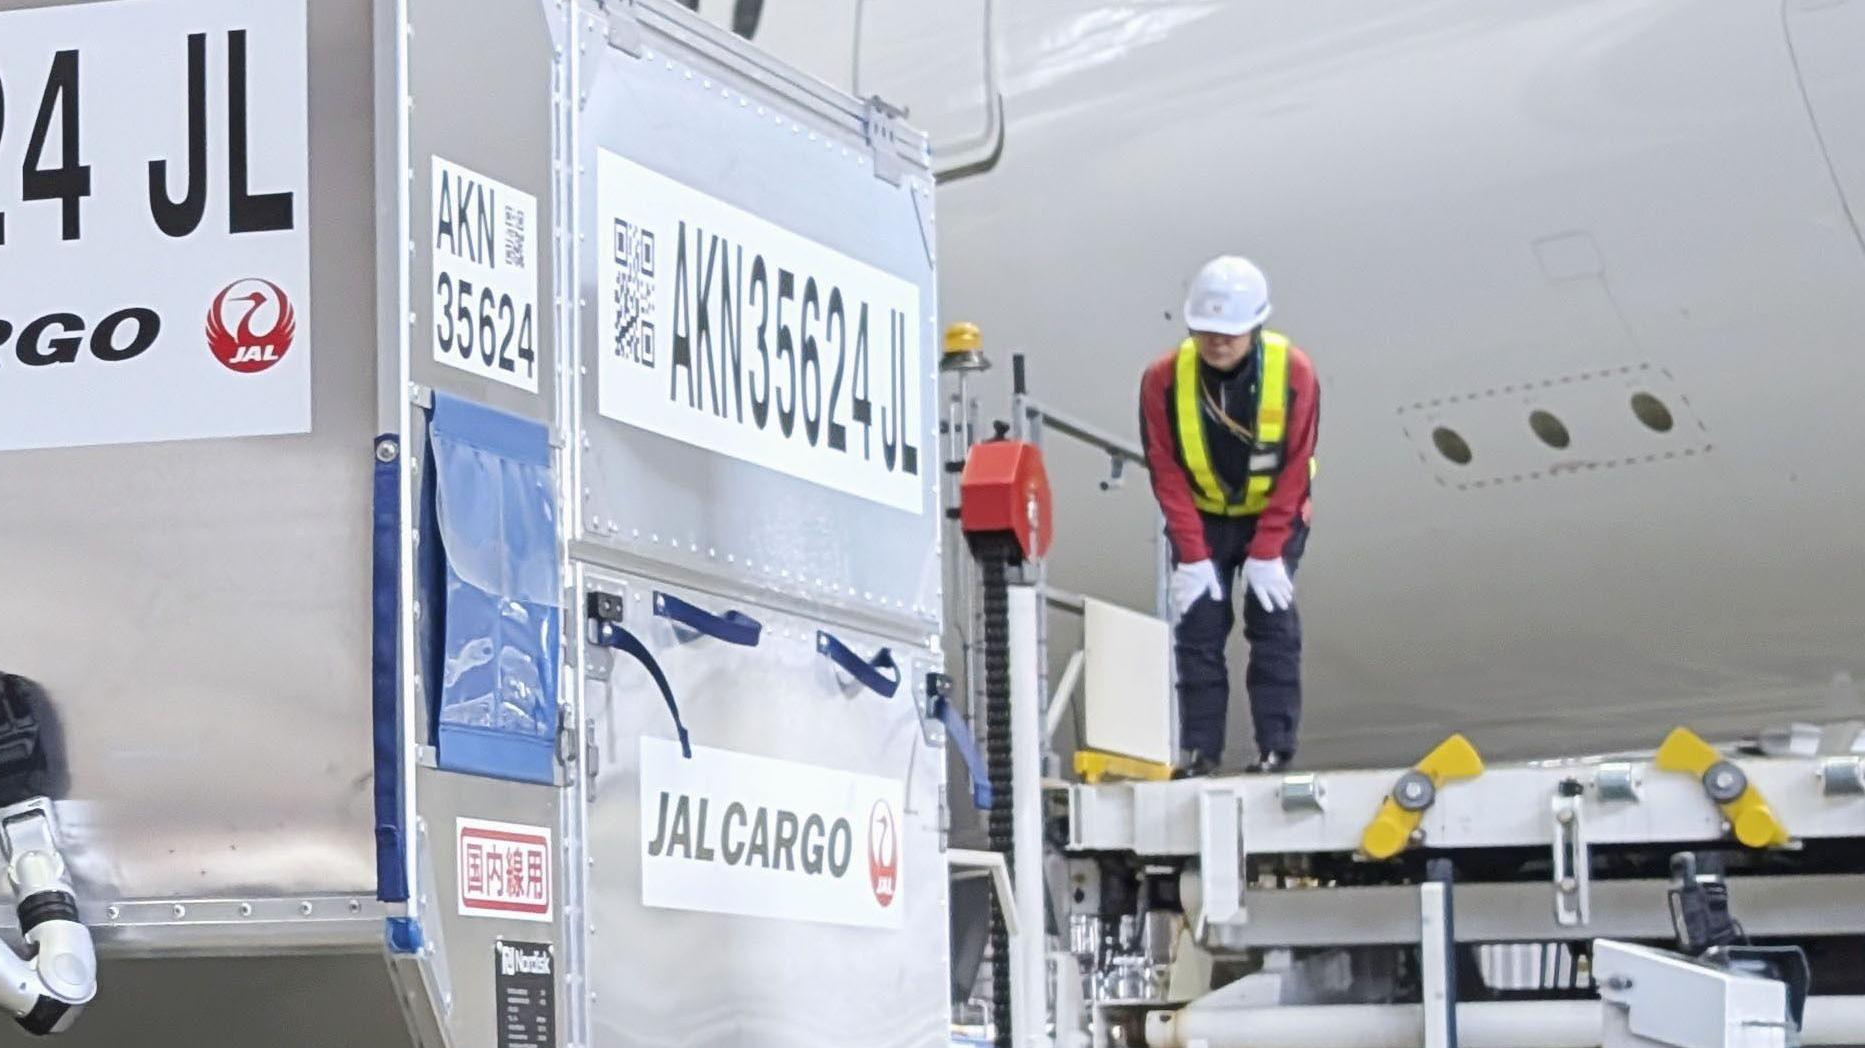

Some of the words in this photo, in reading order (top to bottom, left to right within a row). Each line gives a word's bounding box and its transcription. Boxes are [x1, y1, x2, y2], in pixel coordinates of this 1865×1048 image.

[148, 28, 295, 238] JL
[436, 169, 495, 269] AKN
[229, 344, 279, 364] JAL
[436, 271, 535, 379] 35624
[466, 843, 543, 900] 国内線用
